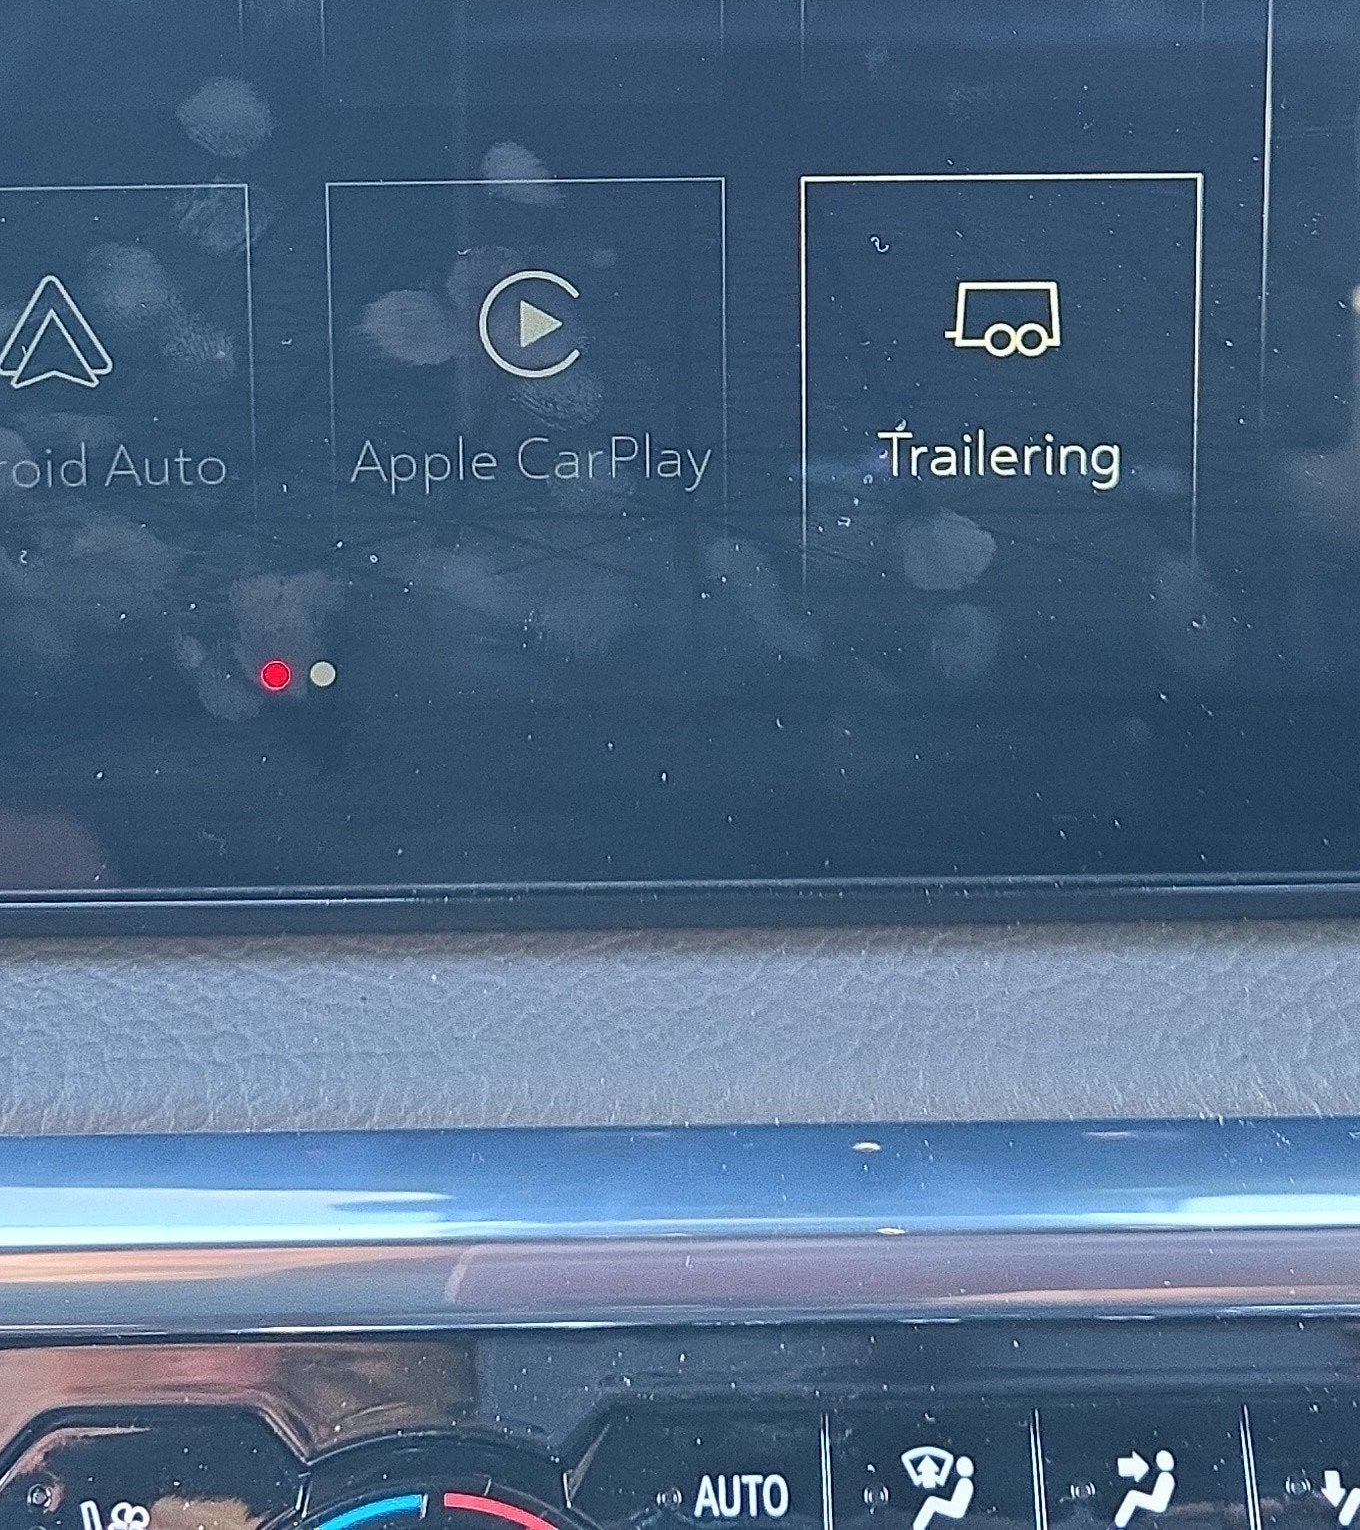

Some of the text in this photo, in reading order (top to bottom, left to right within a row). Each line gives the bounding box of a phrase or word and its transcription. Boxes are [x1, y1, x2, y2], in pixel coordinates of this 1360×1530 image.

[104, 443, 228, 490] Auto
[349, 432, 715, 496] Apple CarPlay
[877, 426, 1124, 491] Trailering
[694, 1474, 790, 1520] AUTO
